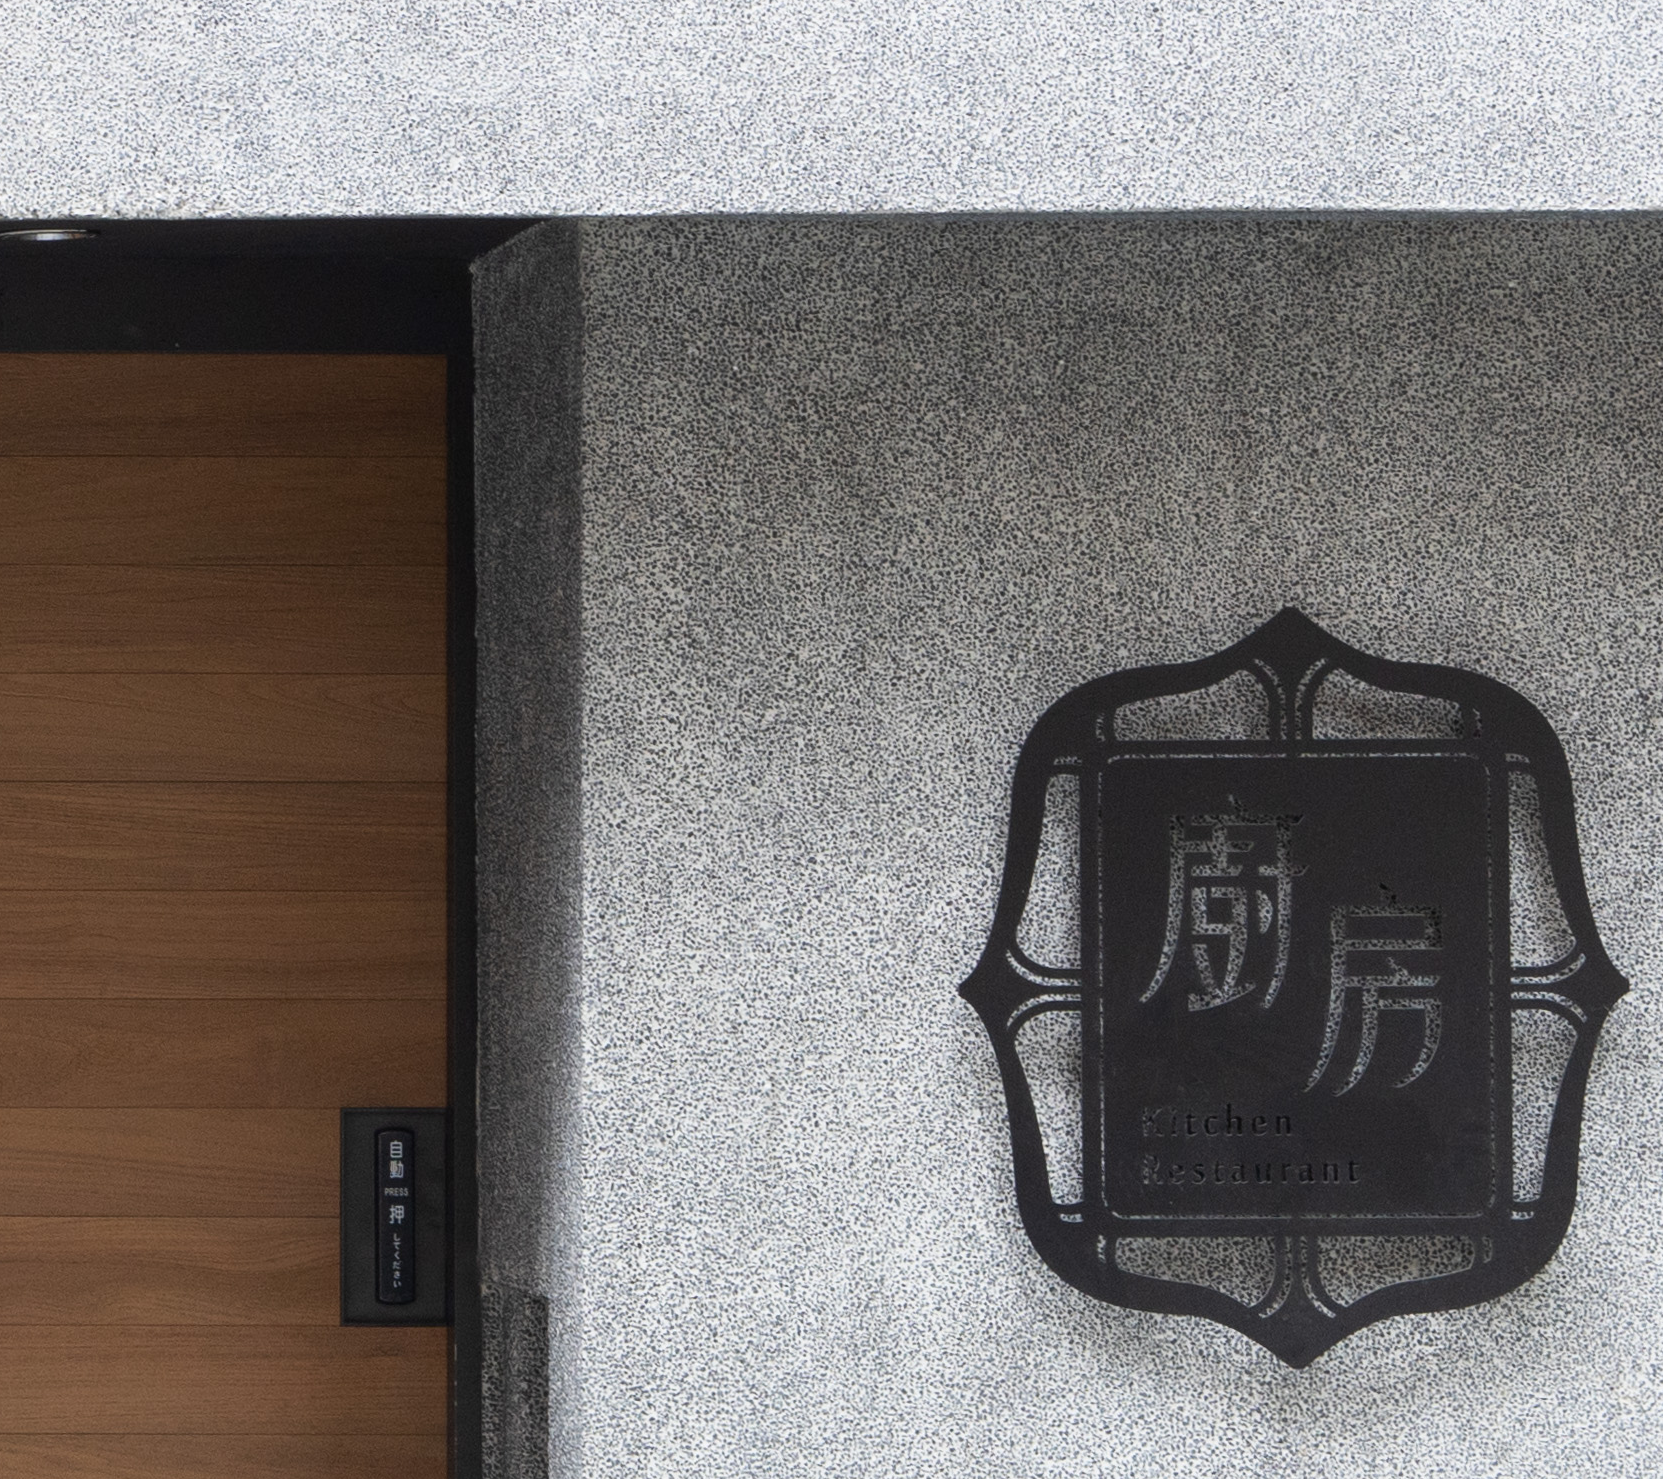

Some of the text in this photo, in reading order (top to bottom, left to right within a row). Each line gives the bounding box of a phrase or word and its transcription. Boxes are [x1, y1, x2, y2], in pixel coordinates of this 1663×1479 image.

[1137, 793, 1446, 1097] 廚房
[1141, 1103, 1294, 1138] Kitchen
[389, 1139, 405, 1179] 自動
[1141, 1154, 1362, 1185] Restaurant
[384, 1187, 409, 1197] PRESS
